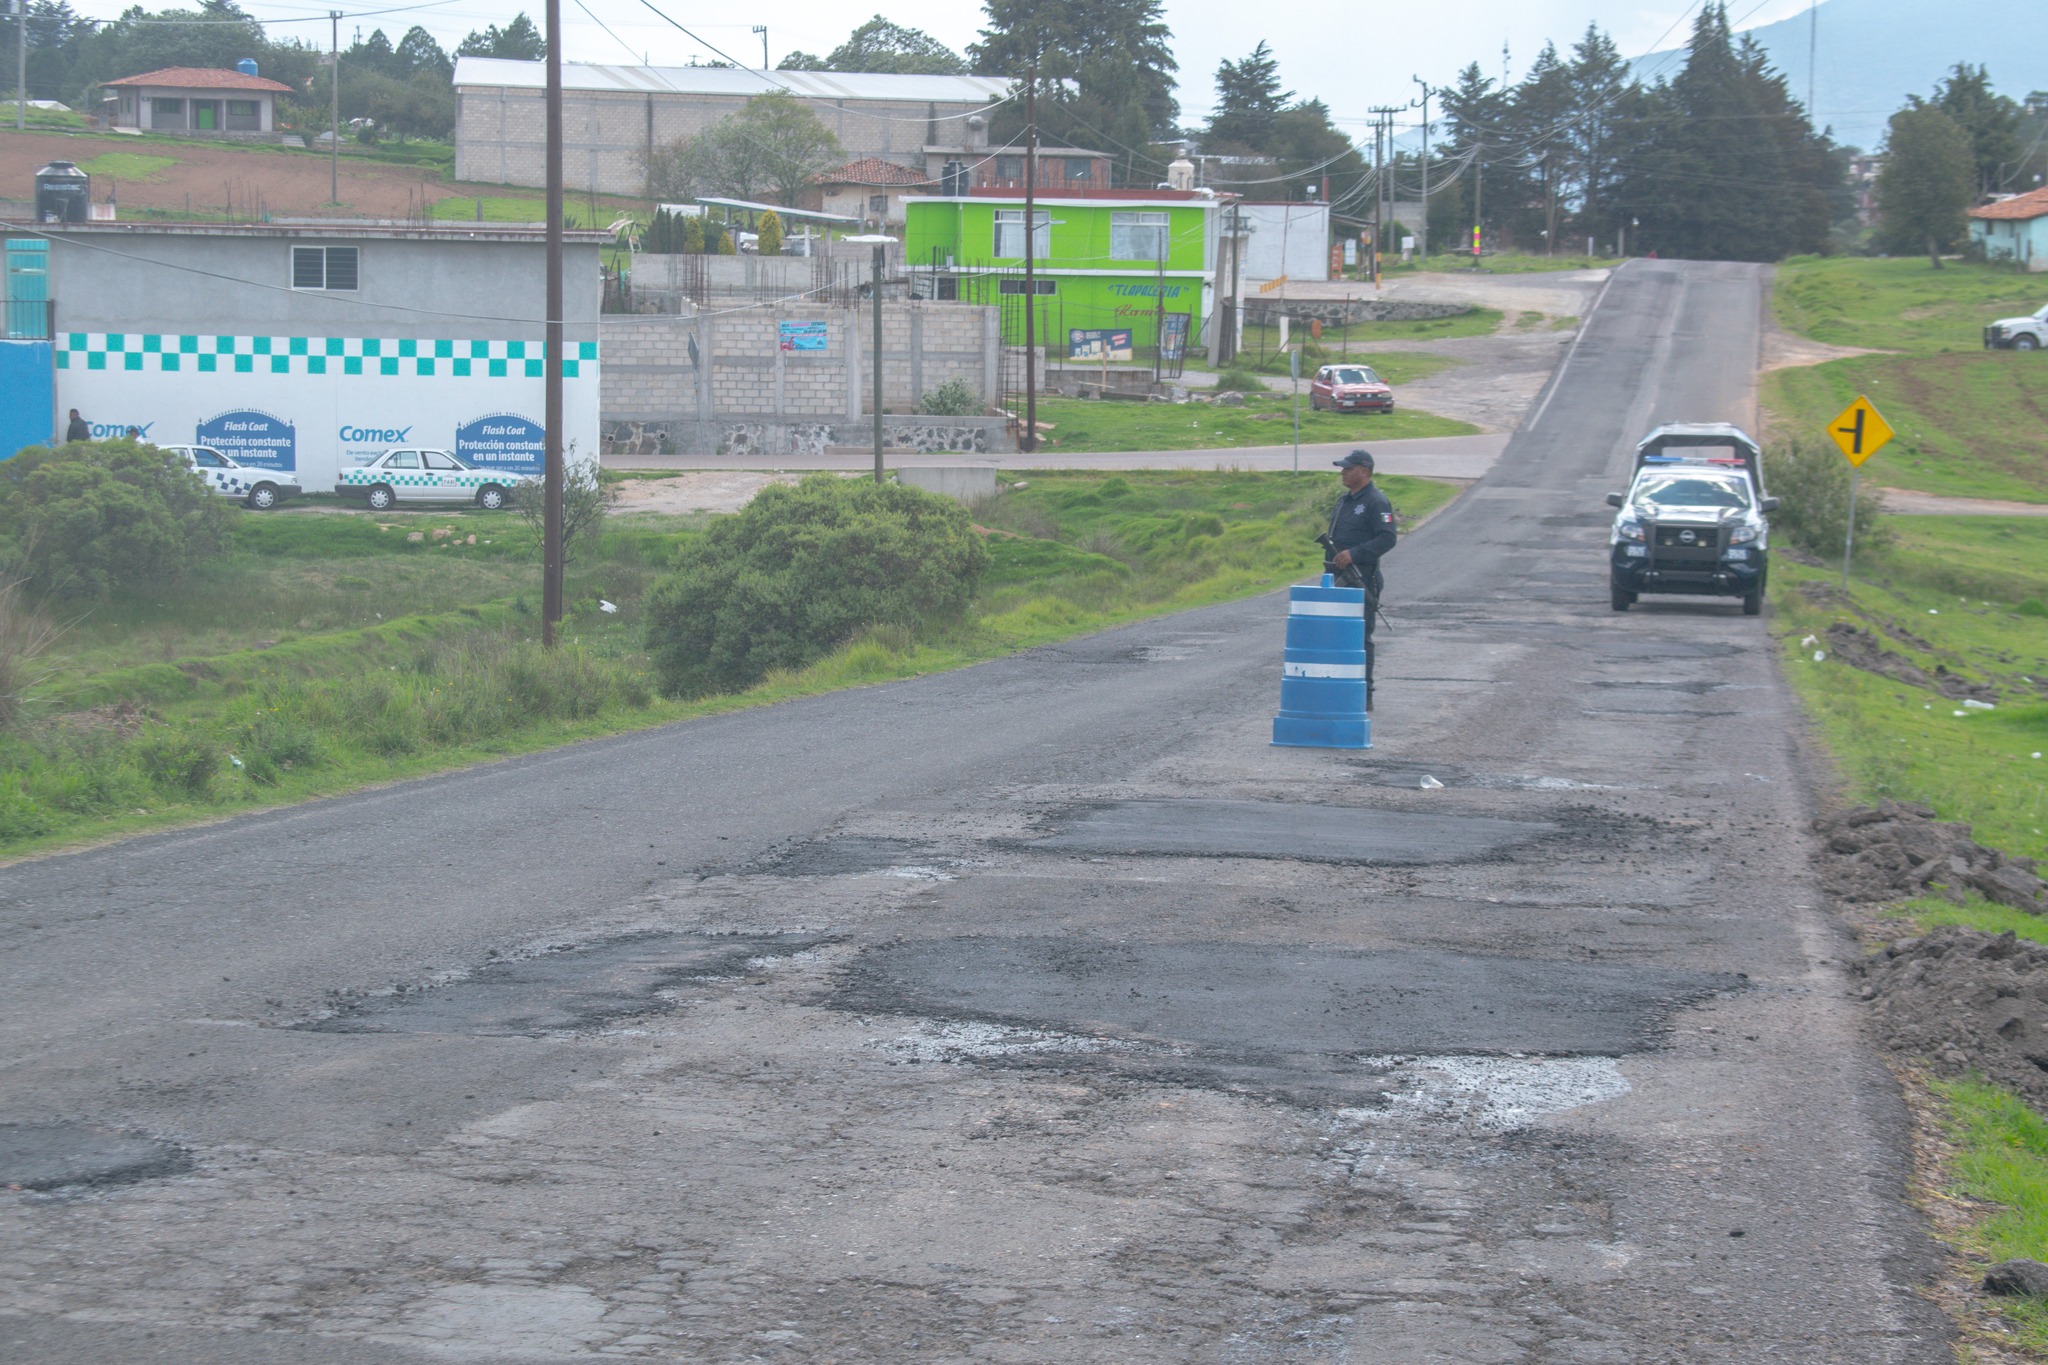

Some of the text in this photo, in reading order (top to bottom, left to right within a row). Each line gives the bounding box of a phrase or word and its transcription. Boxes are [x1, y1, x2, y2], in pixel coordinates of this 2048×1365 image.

[86, 421, 155, 438] omex
[224, 421, 268, 431] Flash Coat
[482, 425, 526, 435] Flash Coat
[339, 425, 413, 443] Comex
[200, 436, 291, 447] Protección constante
[459, 439, 546, 451] Protección constant
[227, 449, 239, 457] un
[240, 447, 277, 458] instante
[473, 451, 535, 461] en un instante
